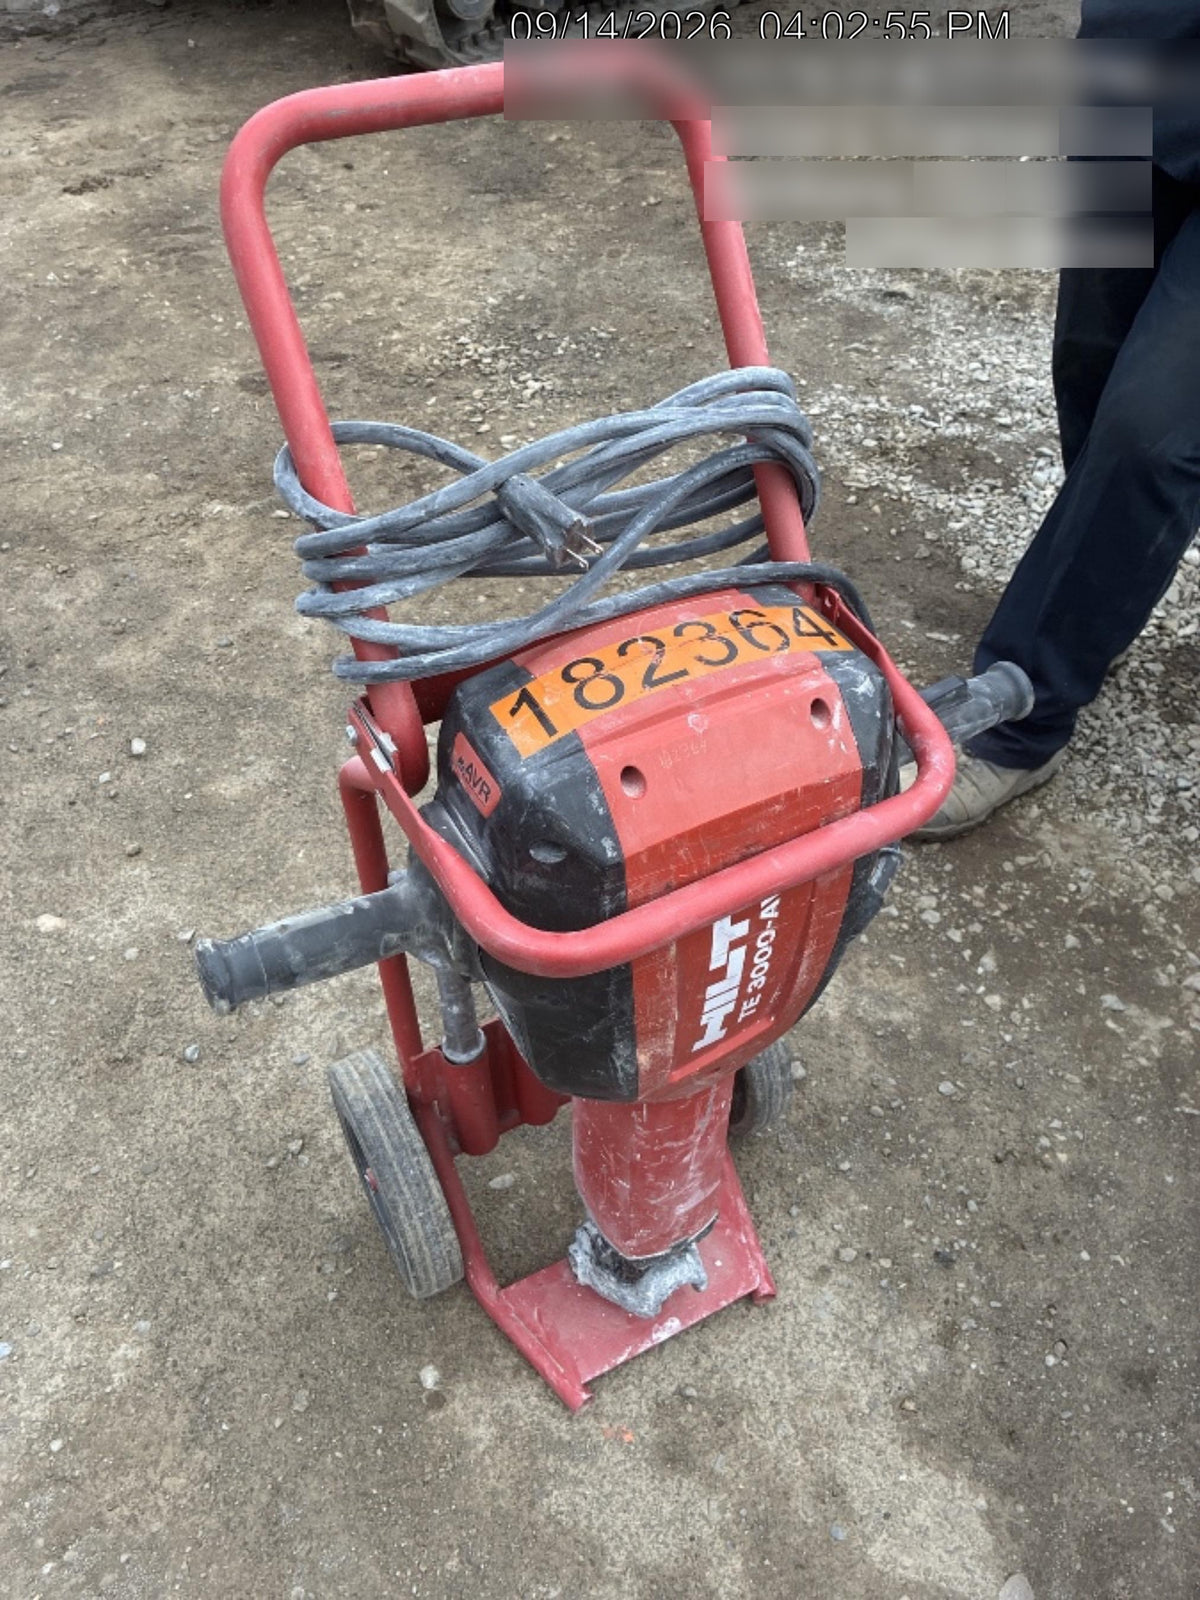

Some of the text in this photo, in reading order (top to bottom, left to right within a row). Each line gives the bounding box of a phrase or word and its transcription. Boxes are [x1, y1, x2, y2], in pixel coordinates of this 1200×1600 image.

[508, 608, 839, 739] 182364
[691, 914, 749, 1052] HILT
[738, 994, 763, 1023] TE
